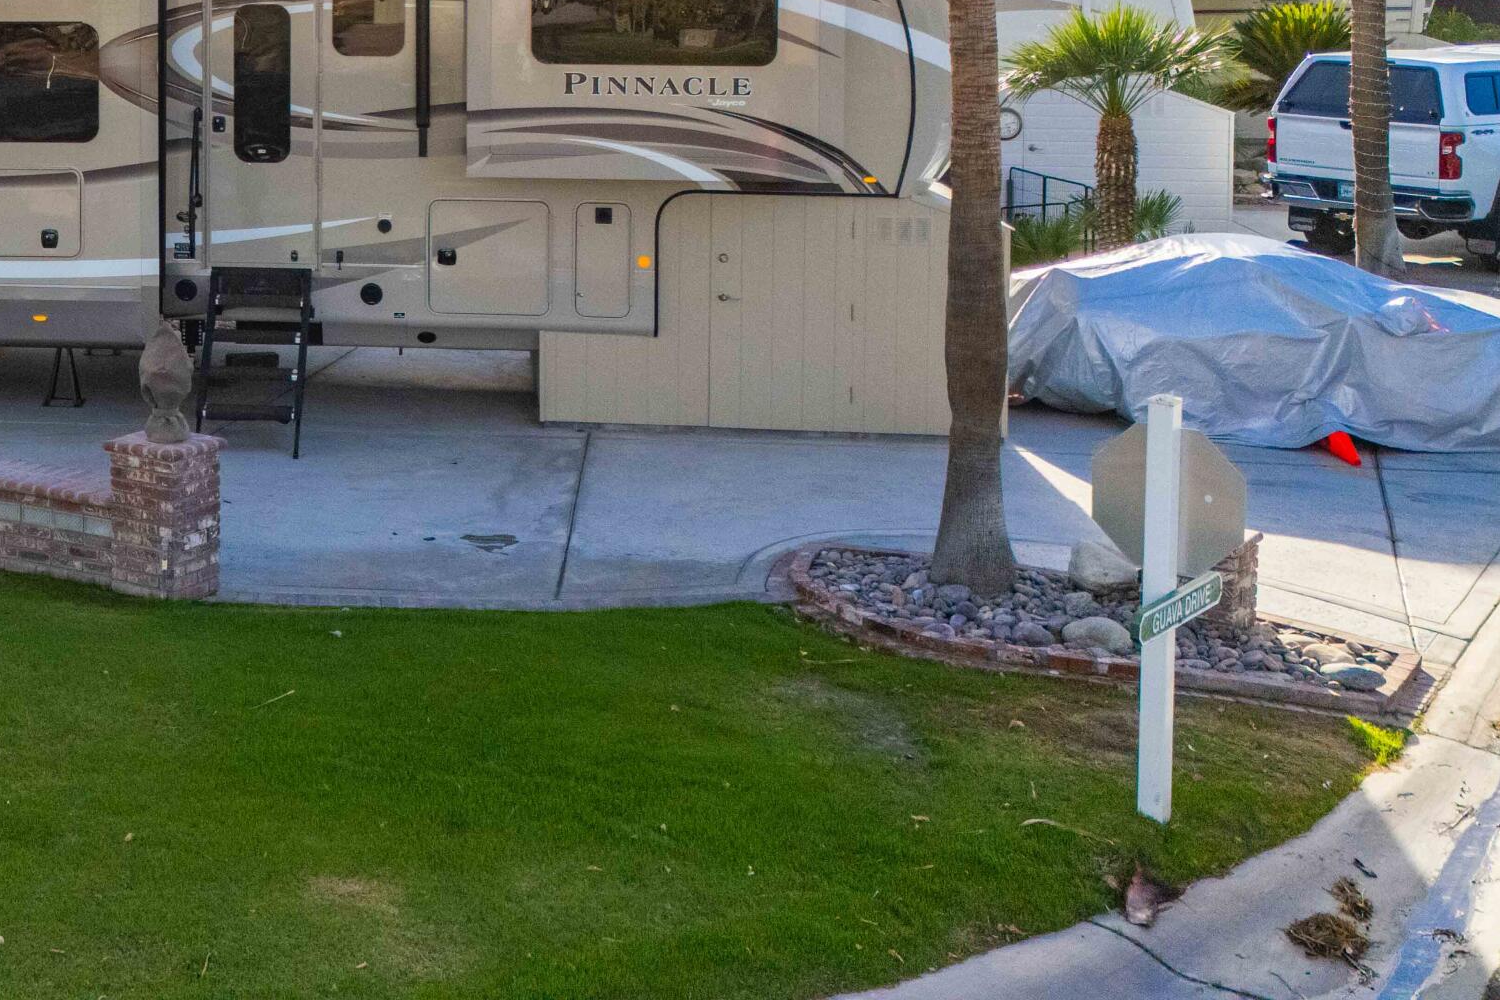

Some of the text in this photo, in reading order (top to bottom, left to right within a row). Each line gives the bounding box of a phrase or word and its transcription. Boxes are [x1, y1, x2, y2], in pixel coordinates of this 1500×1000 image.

[563, 72, 752, 96] PINNACLE
[1152, 583, 1211, 633] GUAVA DRIVE
